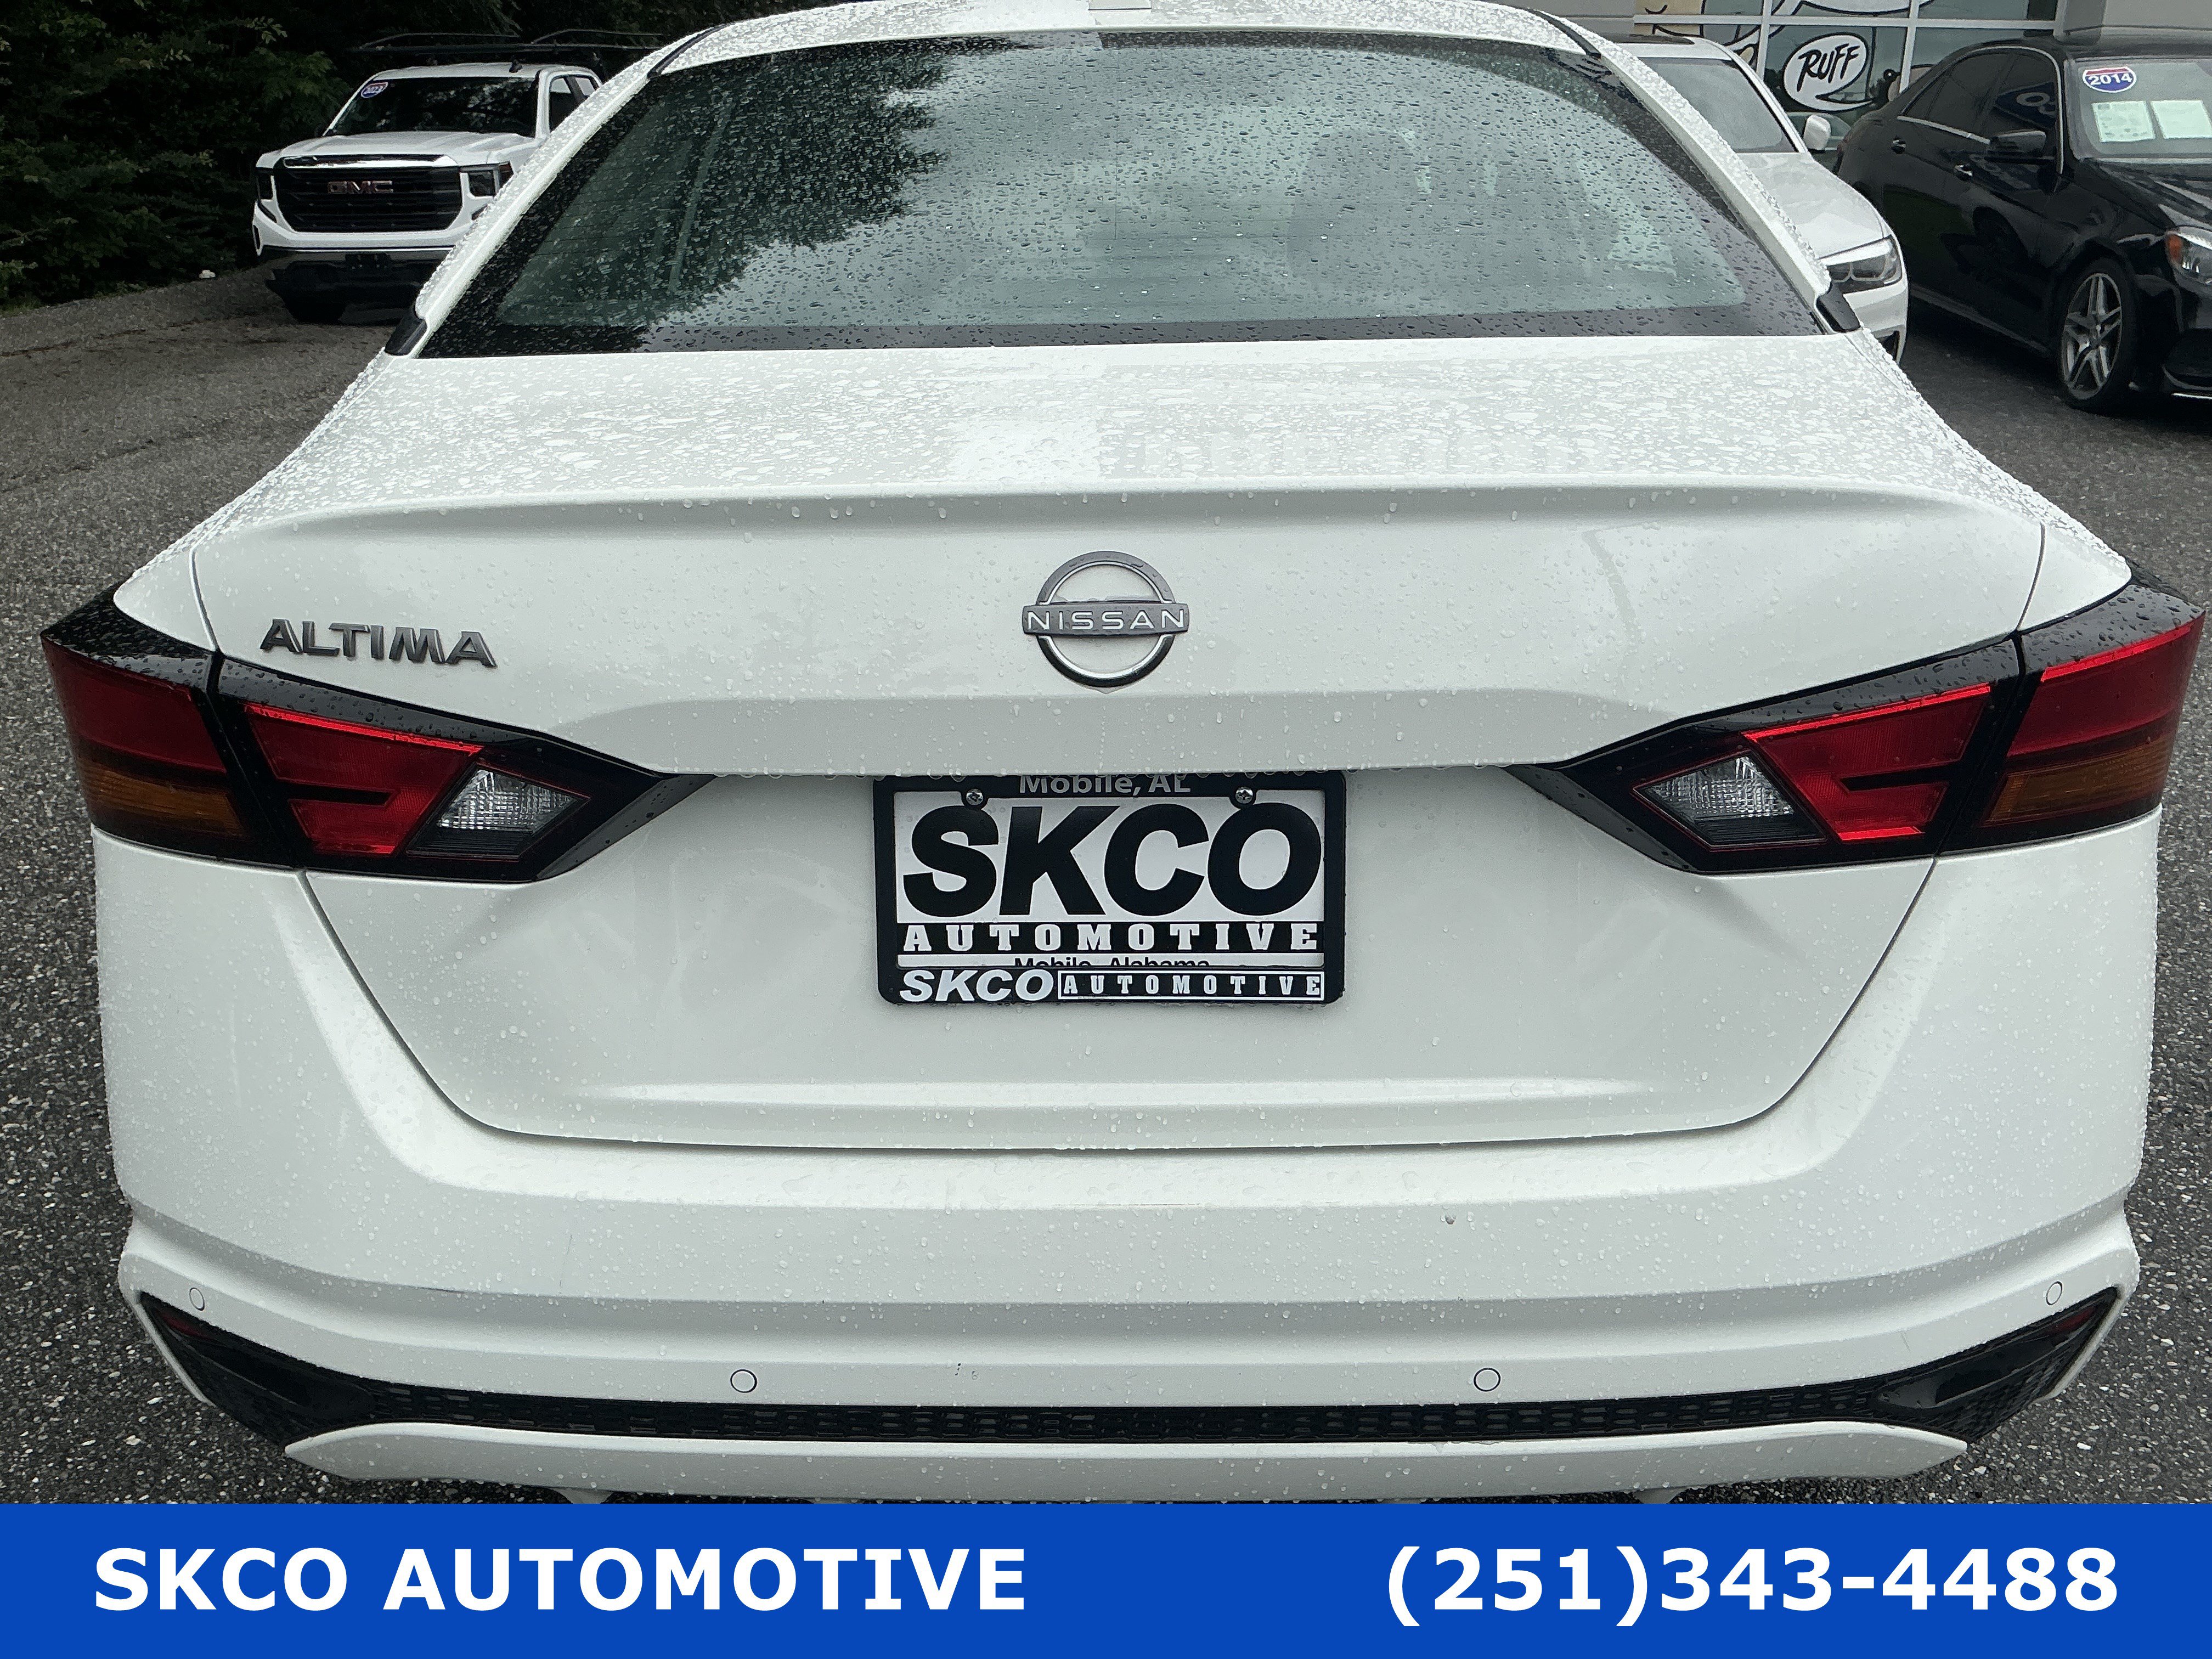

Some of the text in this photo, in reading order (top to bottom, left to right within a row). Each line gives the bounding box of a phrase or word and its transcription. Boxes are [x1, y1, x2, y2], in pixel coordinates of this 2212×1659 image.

[1797, 43, 1860, 92] RUFF
[2088, 73, 2132, 85] 2014
[328, 180, 393, 194] GMC
[1028, 609, 1184, 630] NISSAN
[259, 618, 498, 668] ALTIMA
[1019, 773, 1191, 796] Mobile, AL
[902, 803, 1322, 918] SKCO
[903, 923, 1318, 952] AUTOMOTIVE
[900, 969, 1323, 1002] SKCO AUTOMOTIVE
